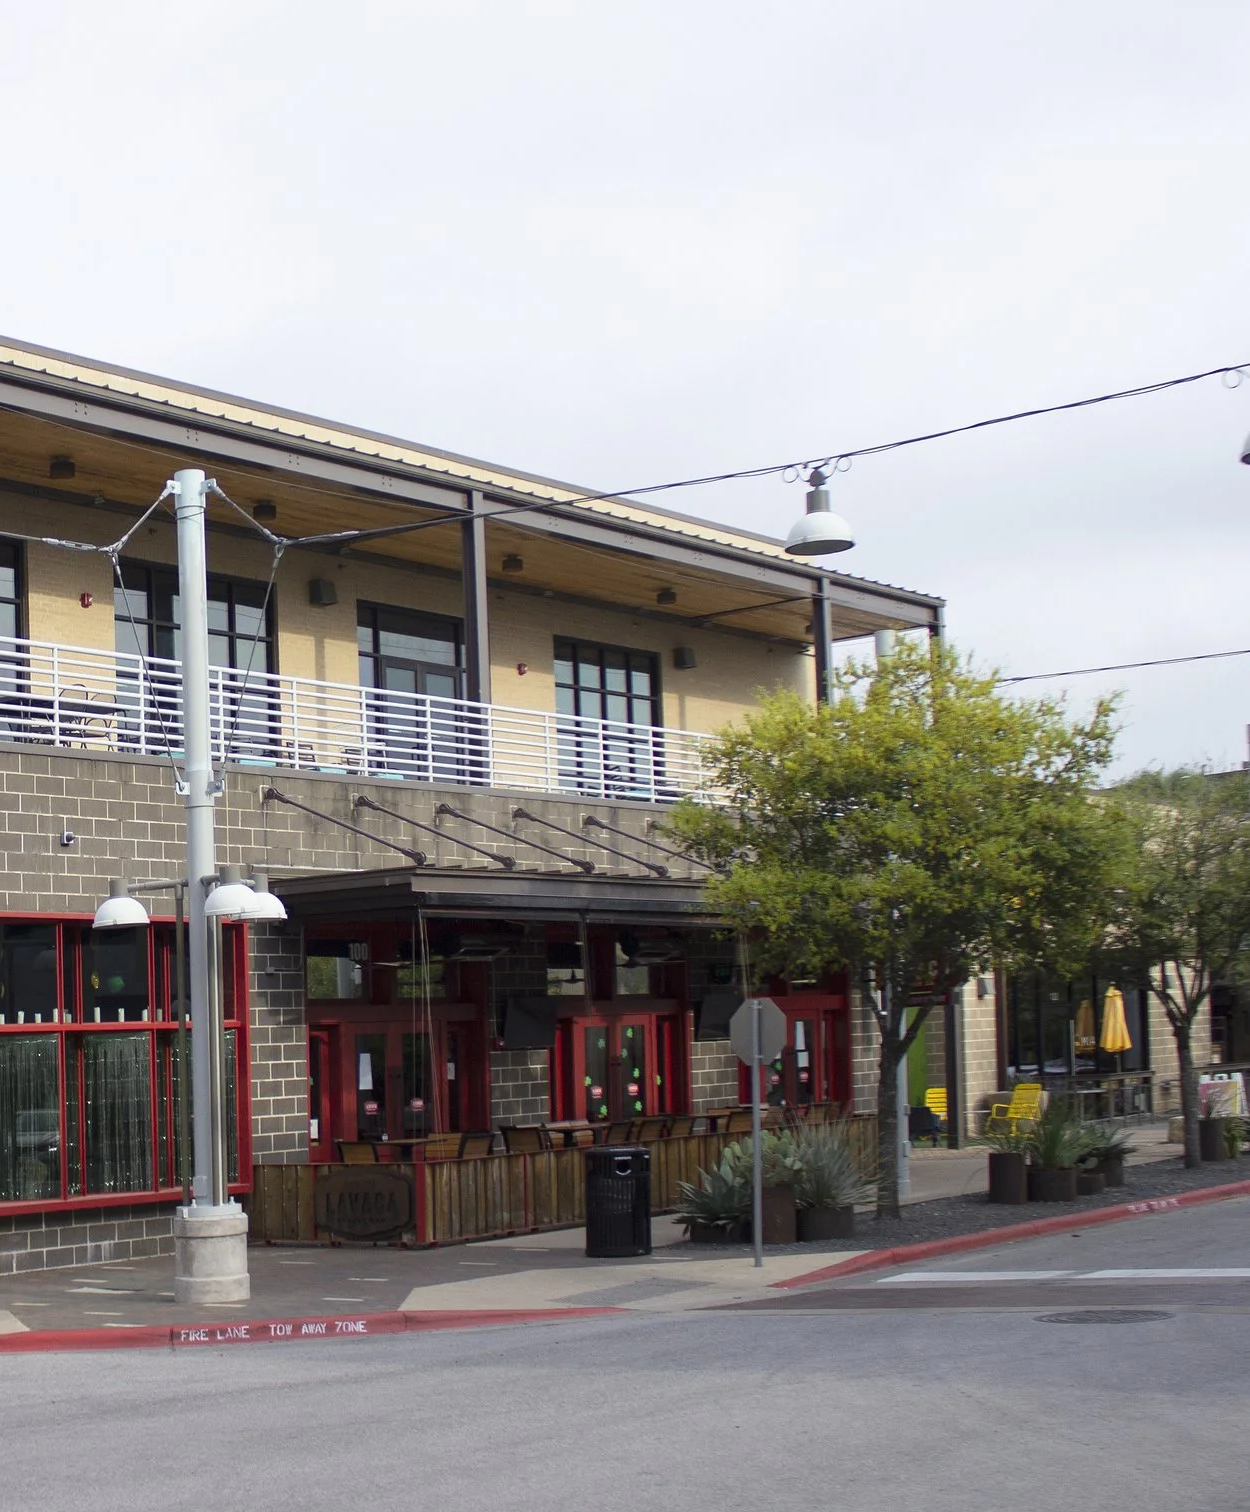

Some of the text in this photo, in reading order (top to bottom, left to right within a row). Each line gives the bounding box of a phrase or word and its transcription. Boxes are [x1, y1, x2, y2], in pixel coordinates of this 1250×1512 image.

[348, 942, 368, 961] 100
[326, 1191, 400, 1218] LAVACA
[181, 1320, 368, 1342] FIRE LANE TOW AWAY ZONE
